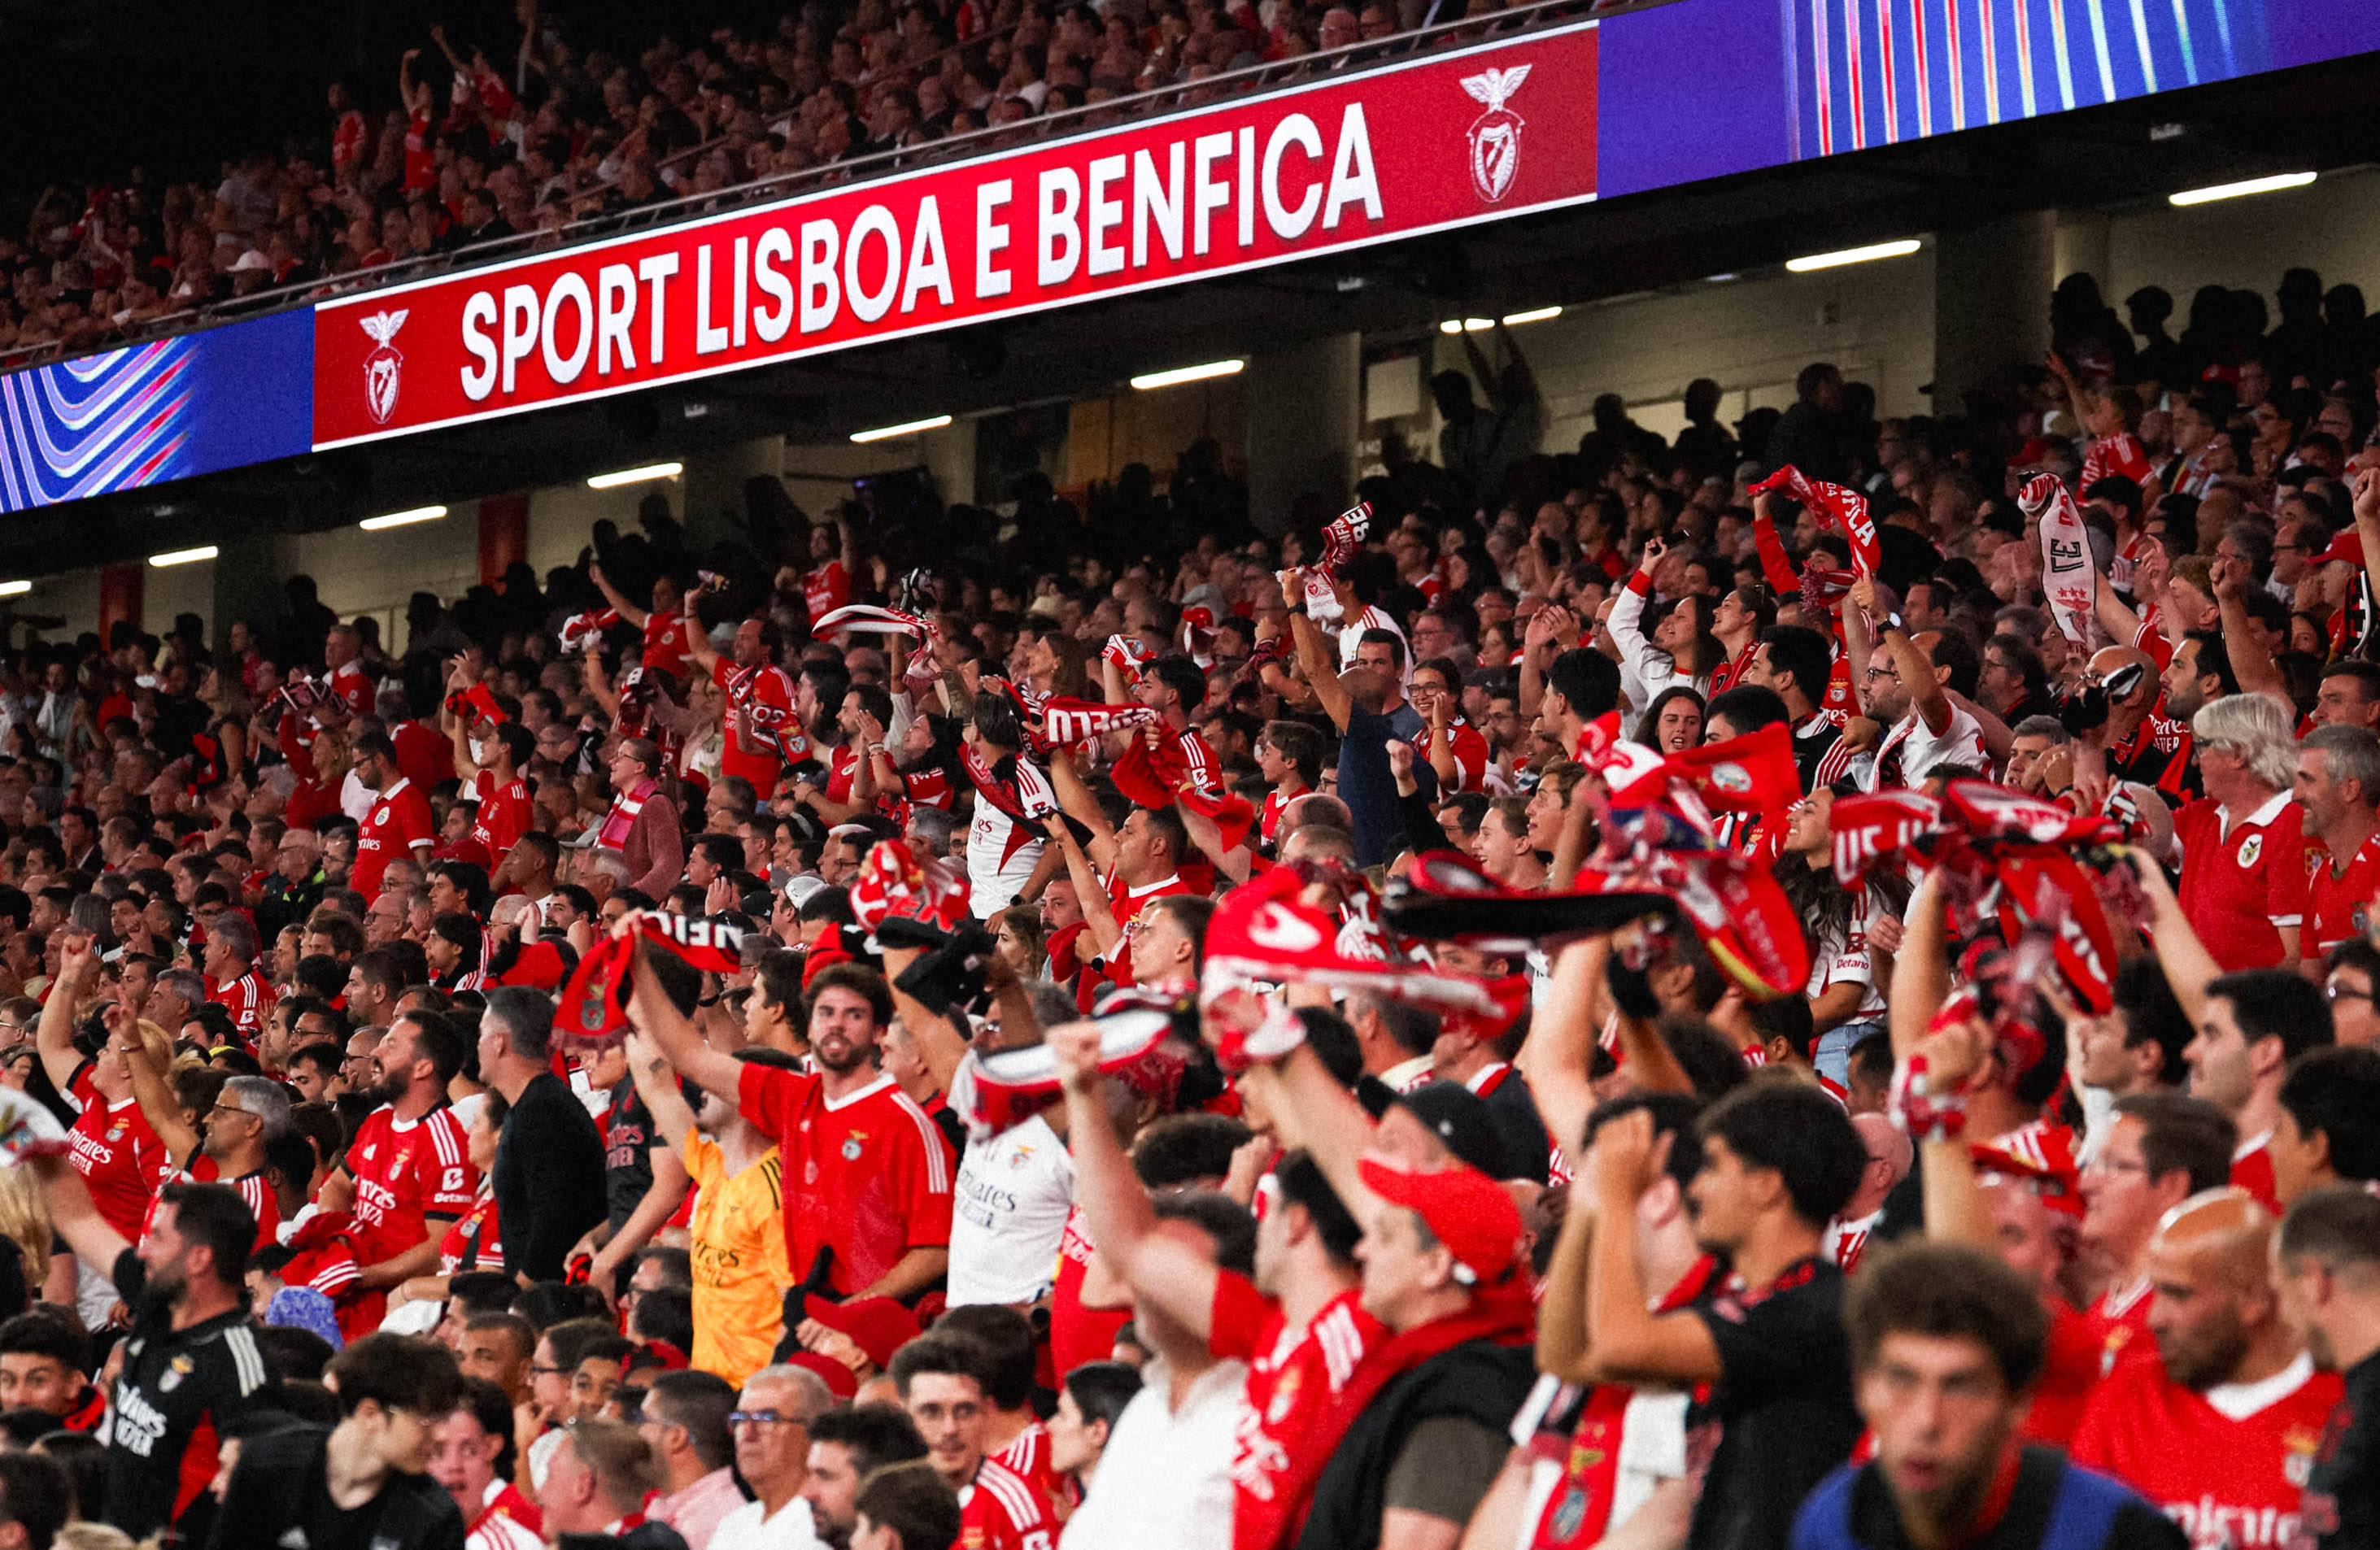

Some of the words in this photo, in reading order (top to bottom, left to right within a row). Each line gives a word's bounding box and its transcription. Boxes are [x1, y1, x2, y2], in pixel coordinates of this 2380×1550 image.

[461, 252, 678, 401] SPORT
[697, 194, 953, 355] LISBOA
[976, 178, 1013, 298] E
[1039, 102, 1383, 286] BENFICA
[1836, 958, 1870, 970] Betano
